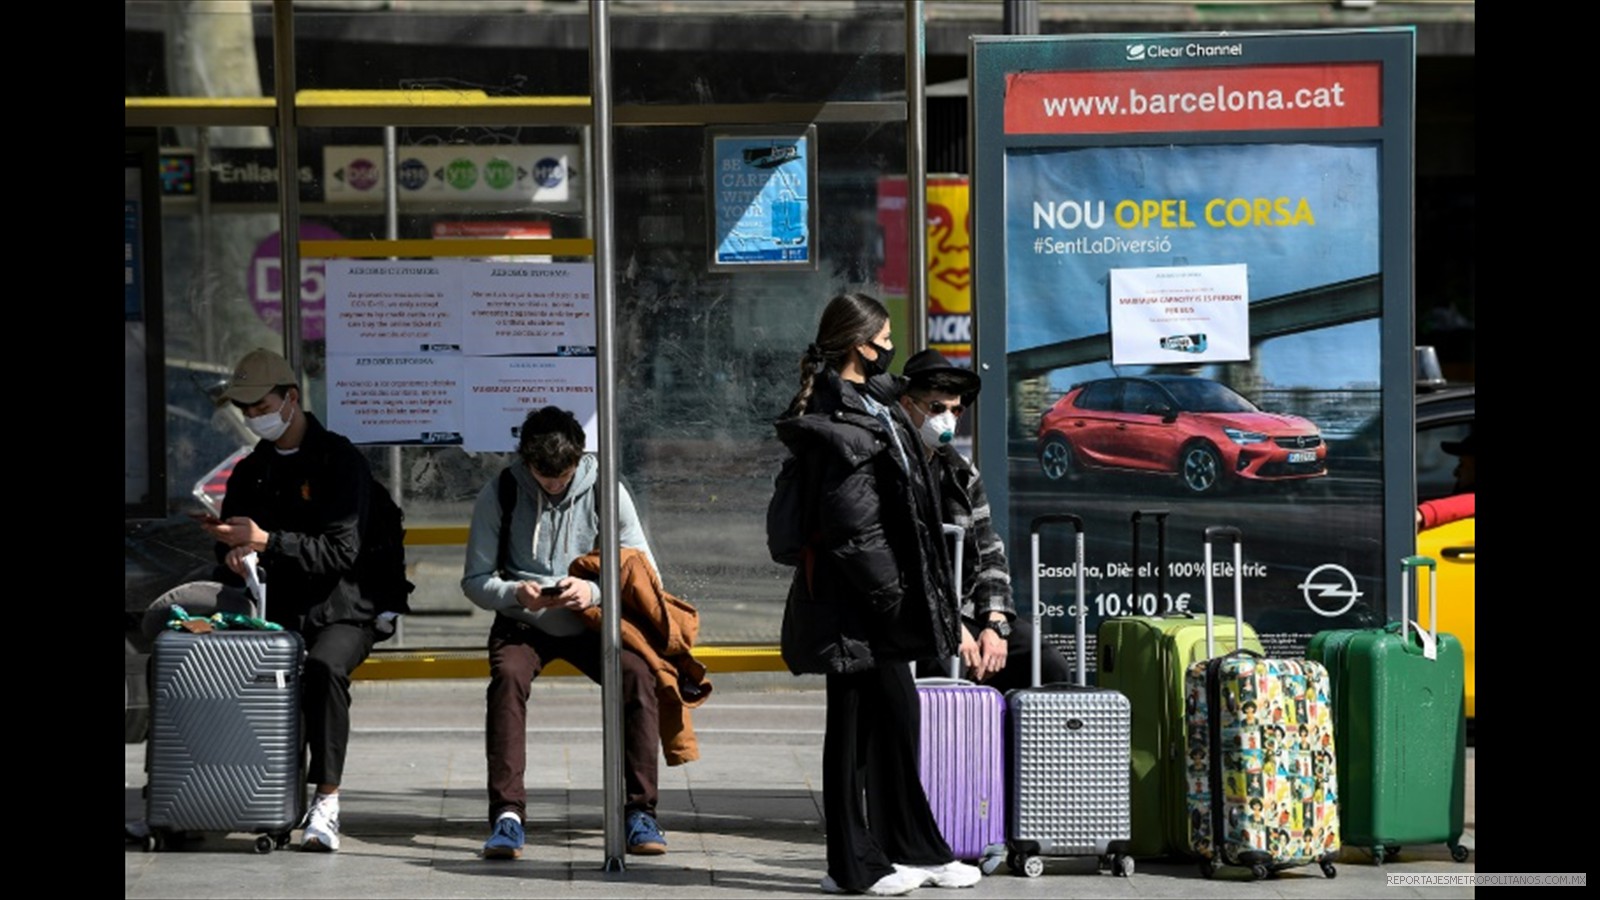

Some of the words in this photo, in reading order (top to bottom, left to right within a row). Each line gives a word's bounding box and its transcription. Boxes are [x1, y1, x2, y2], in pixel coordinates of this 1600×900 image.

[1147, 45, 1184, 57] Clear
[1186, 43, 1242, 57] Channel
[1043, 82, 1344, 117] www.barcelona.cat
[722, 159, 741, 171] BE
[219, 162, 313, 183] Enllas
[722, 174, 801, 187] CAREFUL
[722, 191, 763, 202] WITH
[722, 205, 763, 218] YOUR
[1033, 200, 1105, 230] NOU
[1114, 199, 1196, 229] OPEL
[1205, 197, 1315, 228] CORSA
[1033, 236, 1172, 255] #SentLaDiversió
[255, 258, 325, 302] D5
[1160, 295, 1193, 303] CAPACITY
[1180, 306, 1195, 314] BUS
[1037, 562, 1104, 579] Gasolna,
[1212, 562, 1267, 577] Elètric
